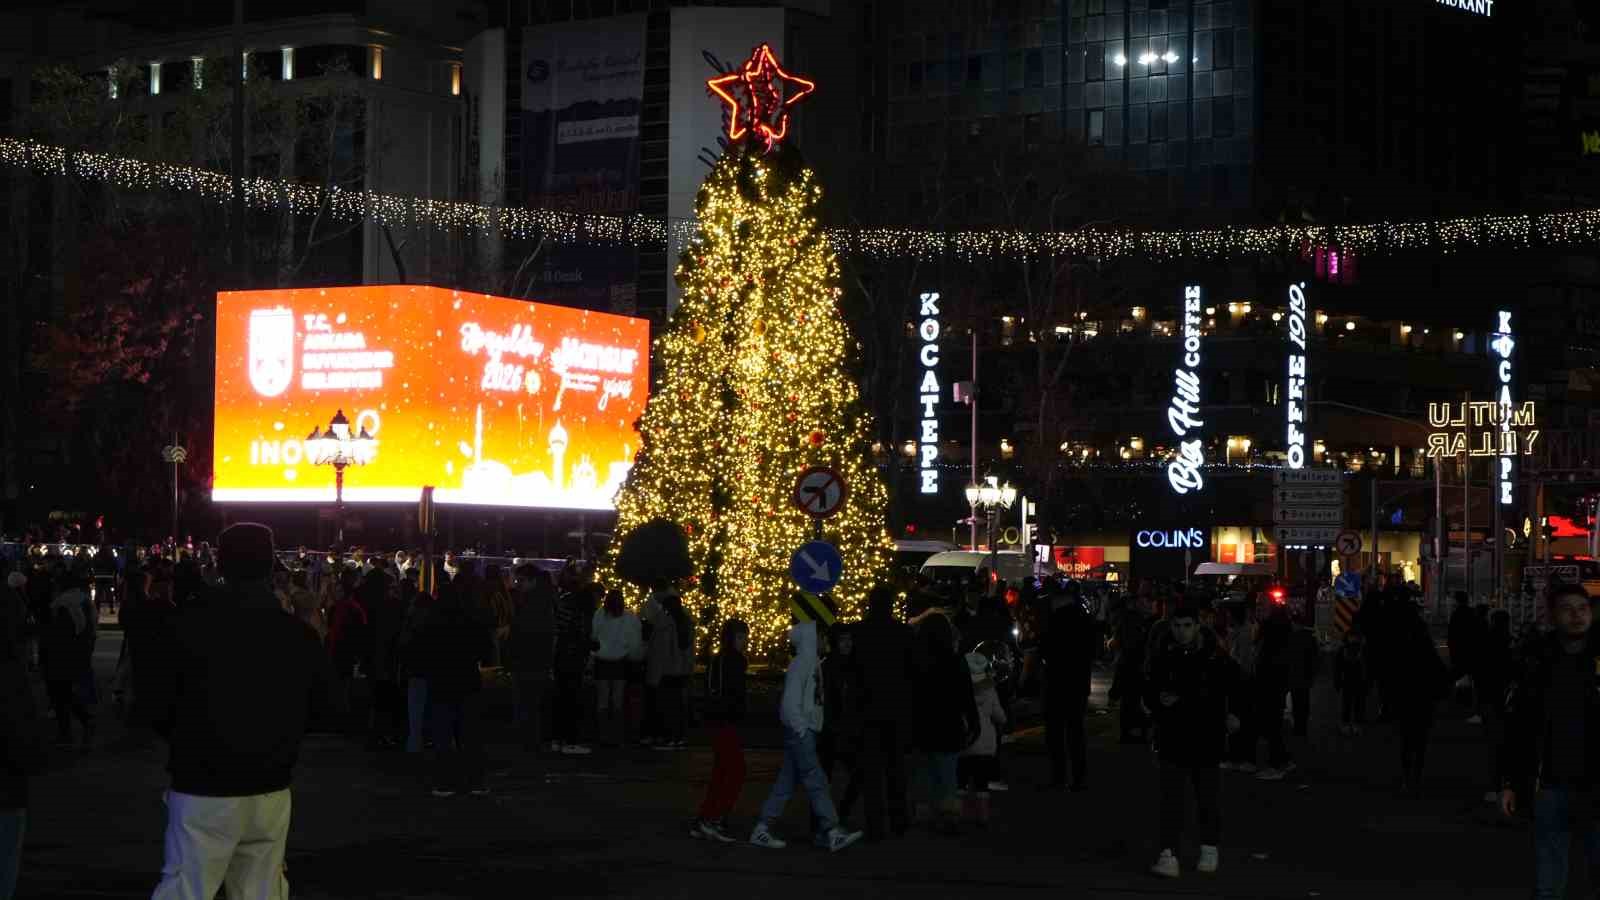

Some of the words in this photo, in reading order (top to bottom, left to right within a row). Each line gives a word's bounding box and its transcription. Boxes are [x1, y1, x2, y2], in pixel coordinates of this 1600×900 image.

[1185, 285, 1201, 367] COFFEE
[481, 362, 524, 392] 2026
[919, 292, 940, 493] KOCATEPE
[1168, 368, 1204, 436] Hill
[1137, 527, 1204, 548] COLIN'S
